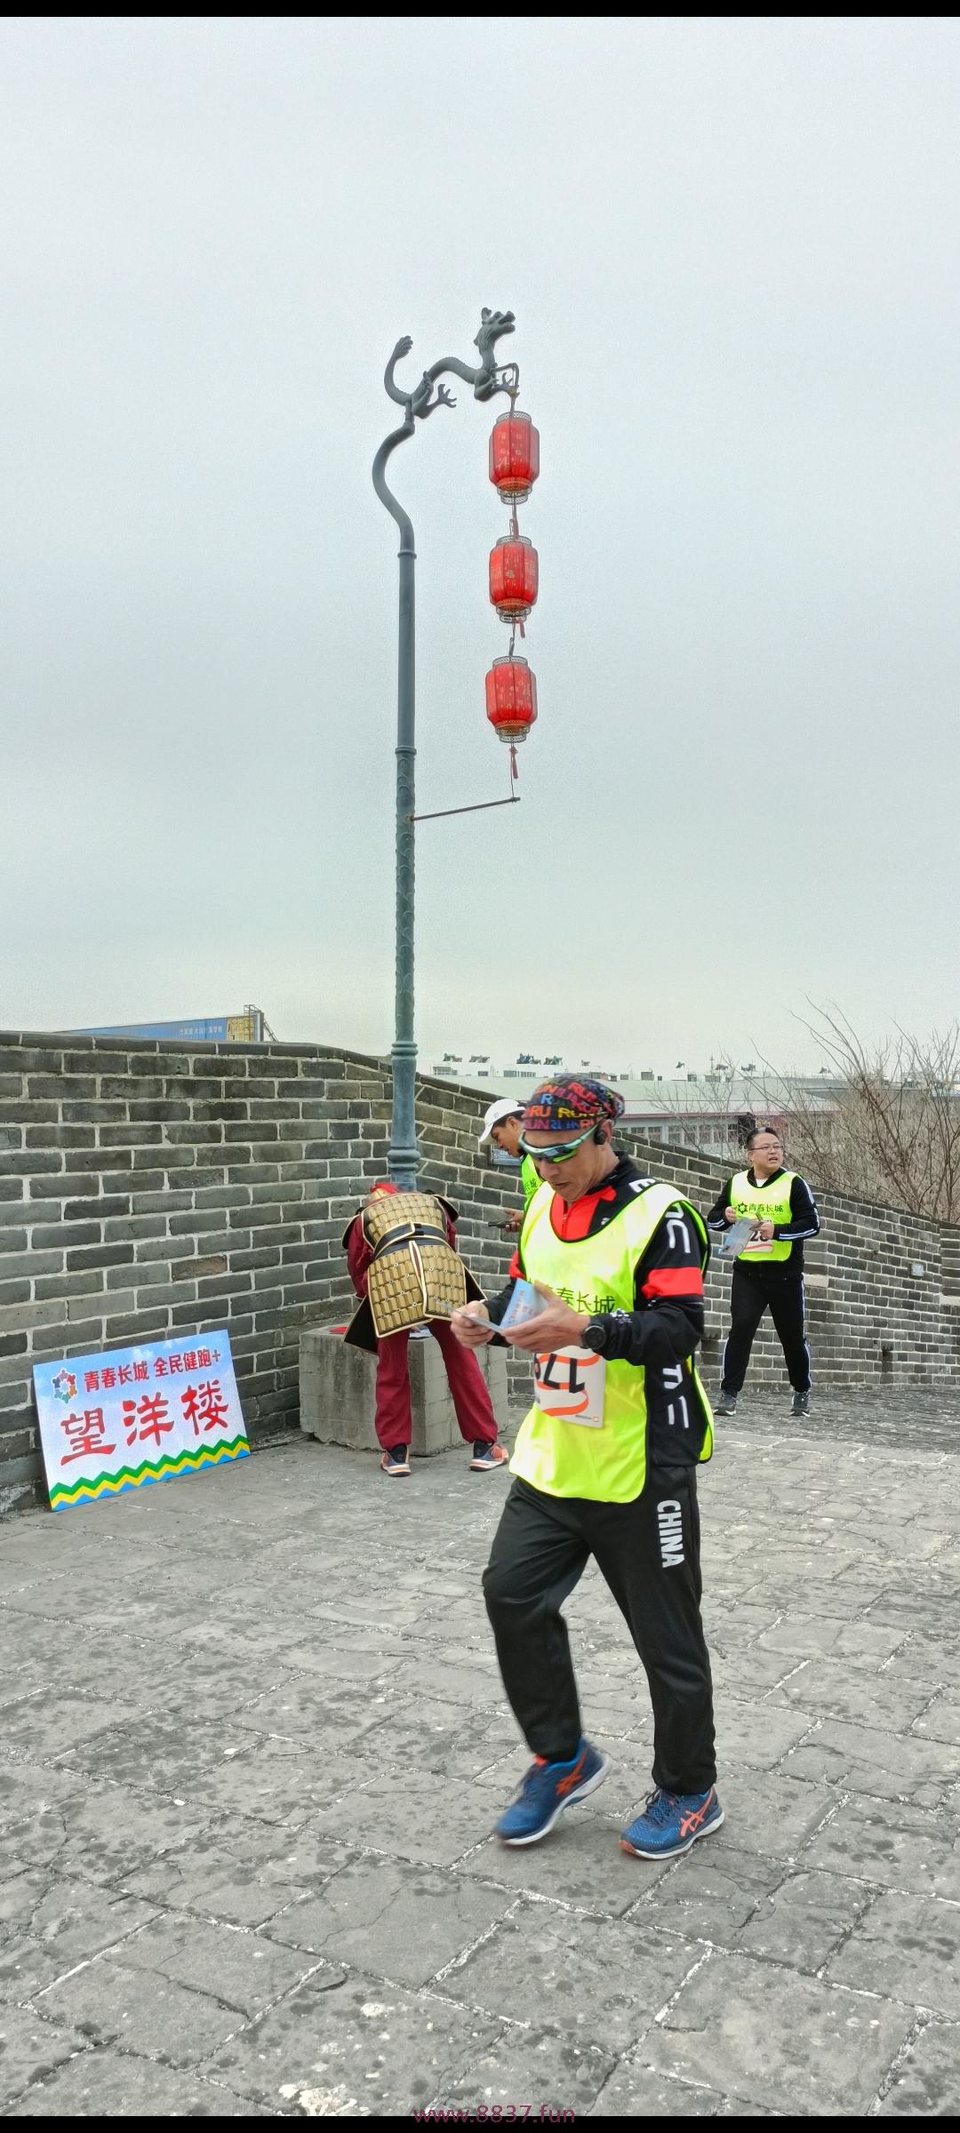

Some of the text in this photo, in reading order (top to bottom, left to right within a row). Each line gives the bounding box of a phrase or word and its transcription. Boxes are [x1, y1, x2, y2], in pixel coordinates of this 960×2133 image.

[547, 1286, 617, 1314] 春长城
[84, 1361, 149, 1392] 青春长城
[60, 1379, 229, 1466] 望洋楼
[656, 1499, 685, 1568] CHINA
